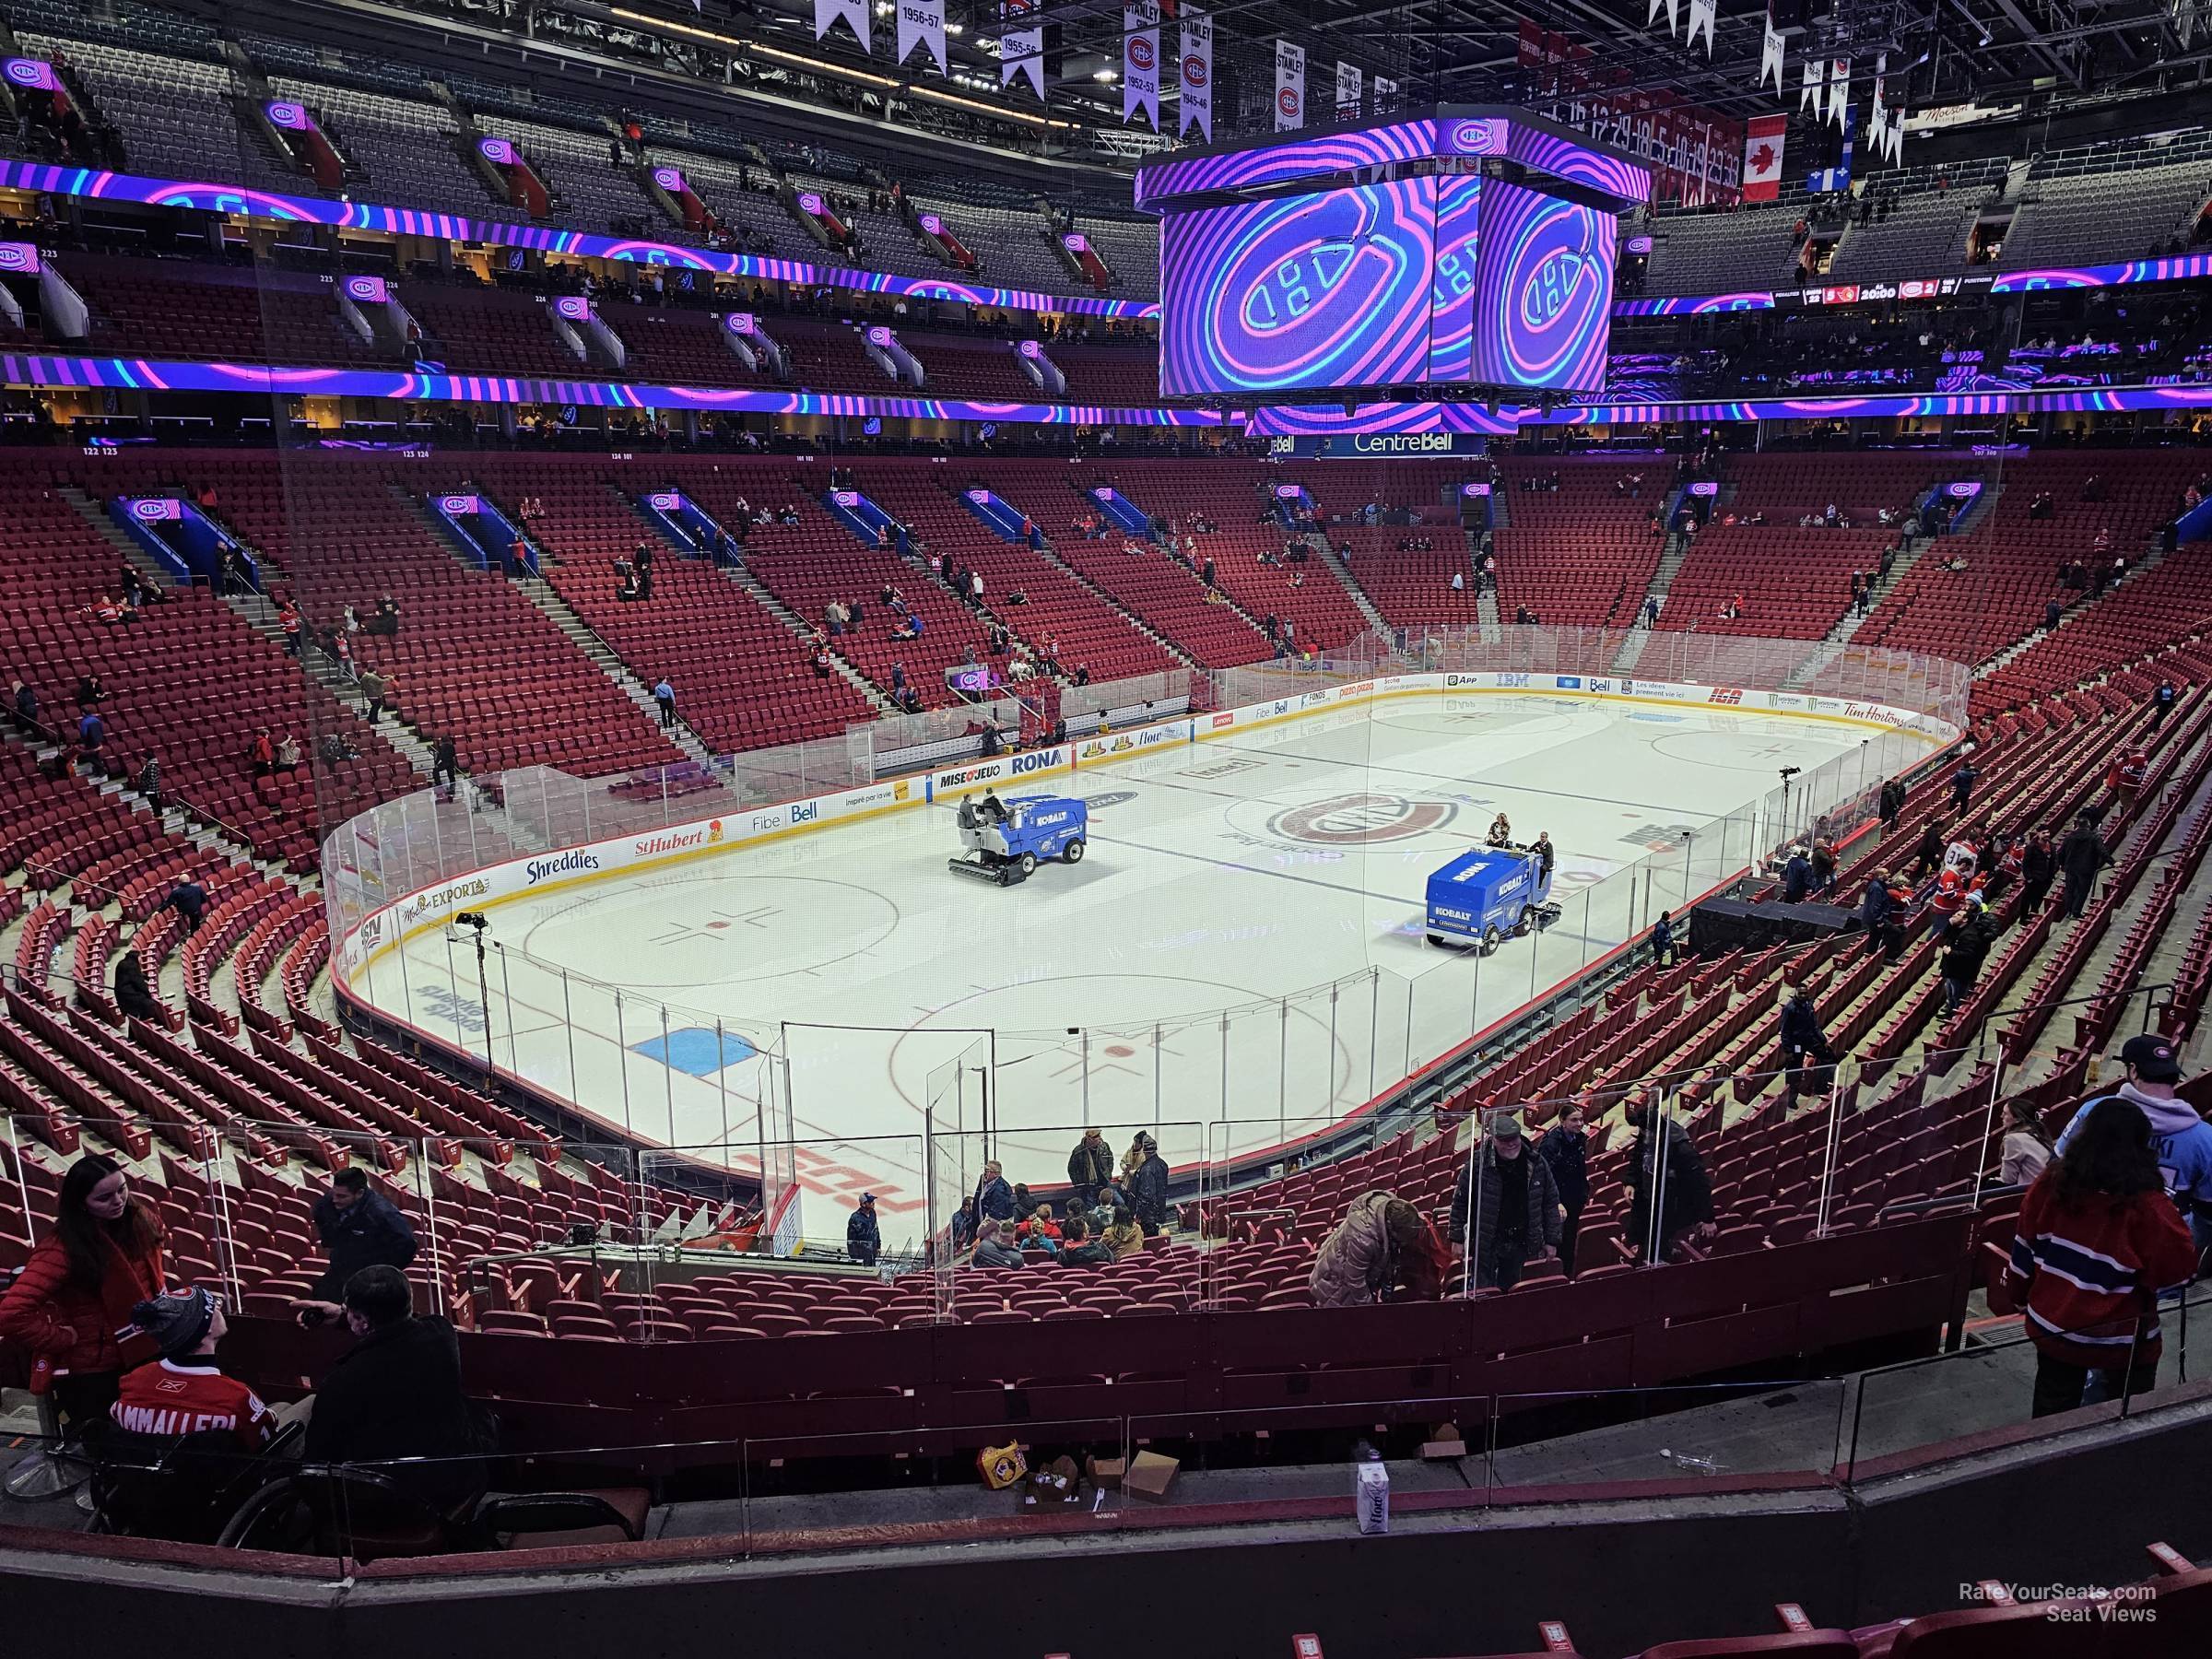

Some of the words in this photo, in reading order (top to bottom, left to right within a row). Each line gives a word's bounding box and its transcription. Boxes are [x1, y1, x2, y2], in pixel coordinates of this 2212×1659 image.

[902, 6, 939, 29] 1956-57
[1181, 21, 1211, 41] STANLEY
[1277, 53, 1303, 75] STANLEY
[1128, 76, 1155, 93] 1952-53
[1183, 93, 1207, 110] 1945-46
[41, 249, 58, 258] 223
[320, 275, 334, 283] 223
[1861, 288, 1897, 300] 20:00
[1924, 283, 1934, 293] 2
[83, 447, 100, 455] 122
[102, 447, 118, 455] 123
[1497, 674, 1530, 688] IBM
[1590, 679, 1610, 691] Bell
[1708, 688, 1744, 706] IGA
[1275, 700, 1288, 714] Bell
[1844, 703, 1865, 719] Tim
[1214, 715, 1232, 725] Lenovo
[1139, 731, 1162, 746] flow
[1012, 749, 1063, 775] RONA
[792, 801, 818, 823] Bell
[1036, 811, 1067, 827] KOBALT
[753, 814, 781, 832] Fibe
[527, 849, 599, 885] Shreddies
[1453, 862, 1492, 882] RONA
[1499, 875, 1523, 897] KOBALT
[1435, 906, 1472, 922] KOBALT
